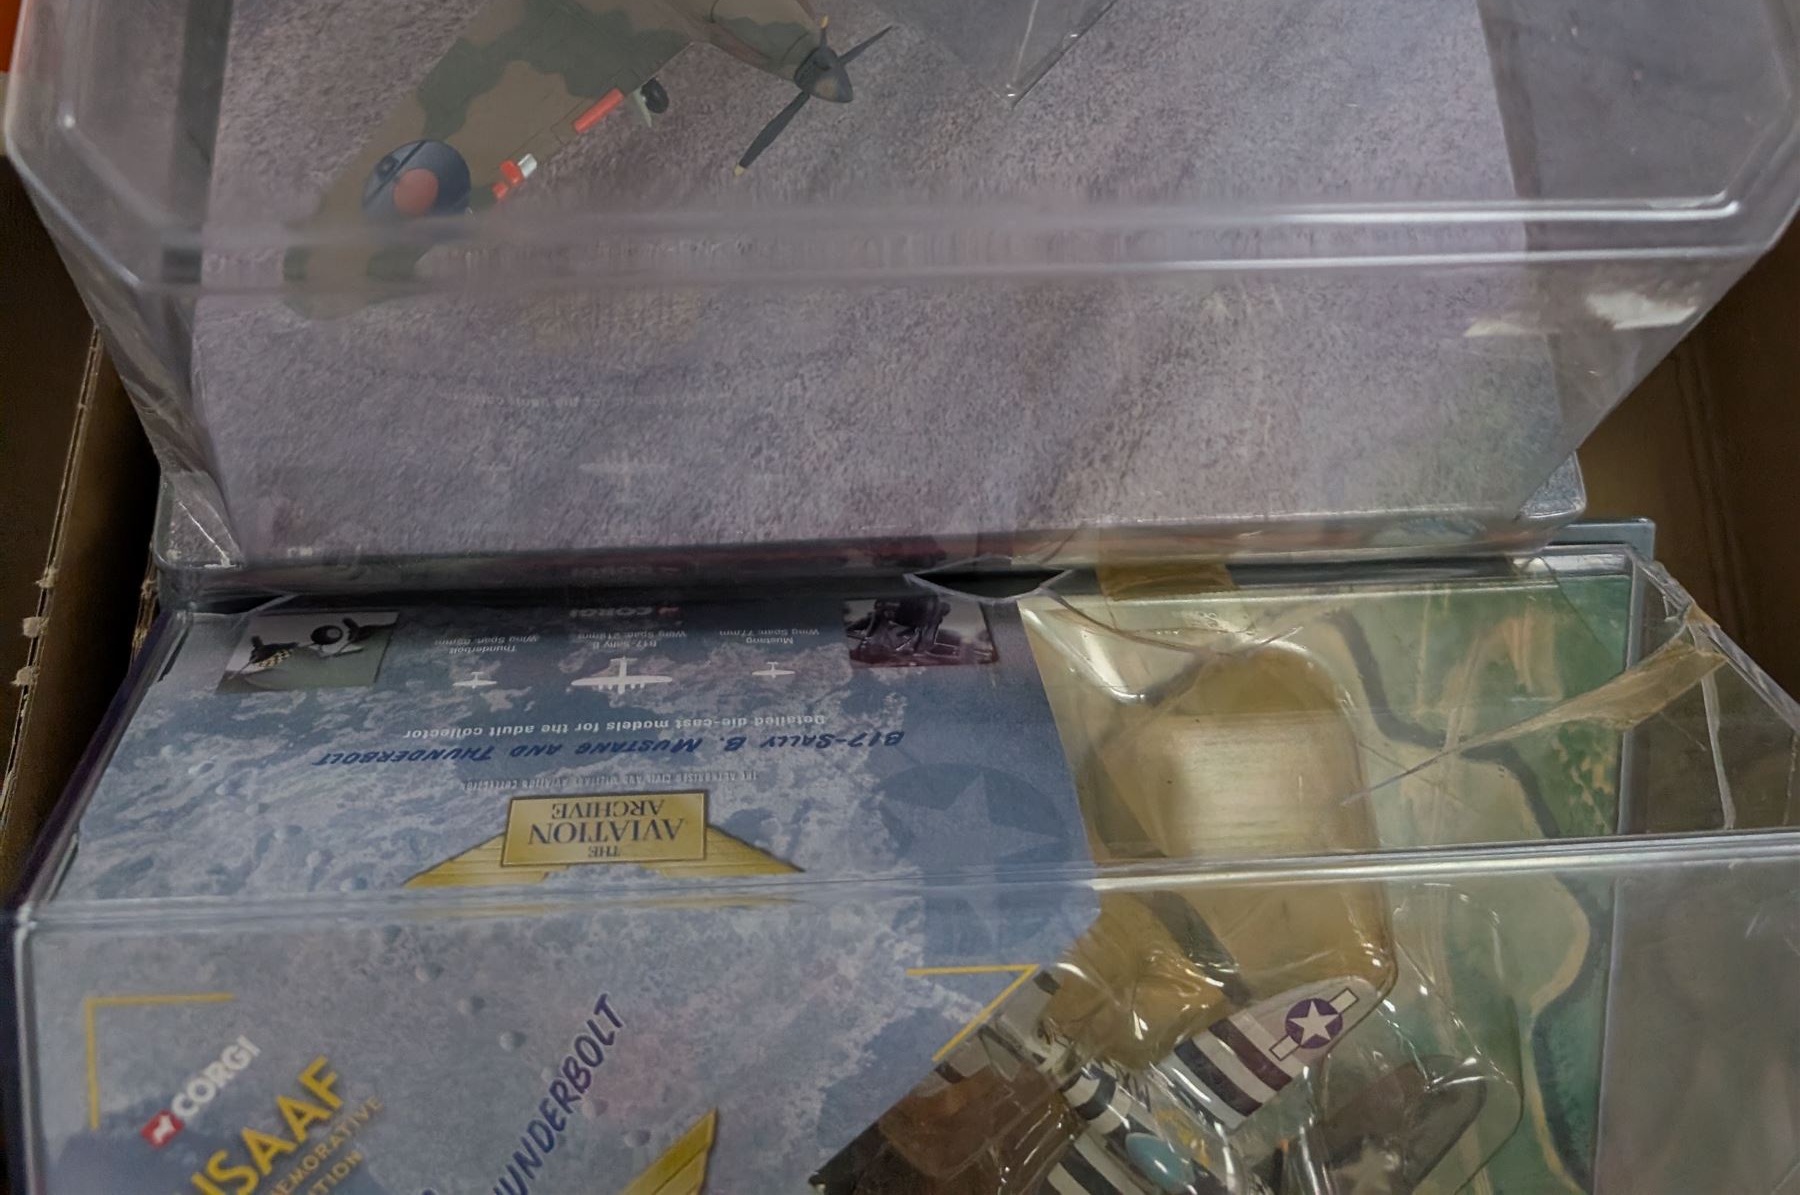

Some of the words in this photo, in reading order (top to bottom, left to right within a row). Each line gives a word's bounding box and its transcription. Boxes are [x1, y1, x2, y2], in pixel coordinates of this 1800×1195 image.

[745, 636, 794, 645] Mustang
[574, 721, 600, 732] for
[606, 719, 669, 731] models
[676, 717, 748, 729] die-cast
[754, 715, 826, 726] Detailed
[403, 726, 483, 739] collector
[489, 725, 535, 736] adult
[541, 723, 569, 734] the
[511, 744, 563, 757] AND
[575, 738, 704, 755] MUSTANG
[720, 736, 747, 752] B.
[312, 745, 496, 767] THUNDERBOLT
[551, 799, 664, 819] ARCHIVE
[528, 818, 684, 845] AVIATION
[588, 845, 621, 858] THE
[171, 1035, 261, 1117] CORGI
[493, 993, 623, 1195] UNDERBOLT
